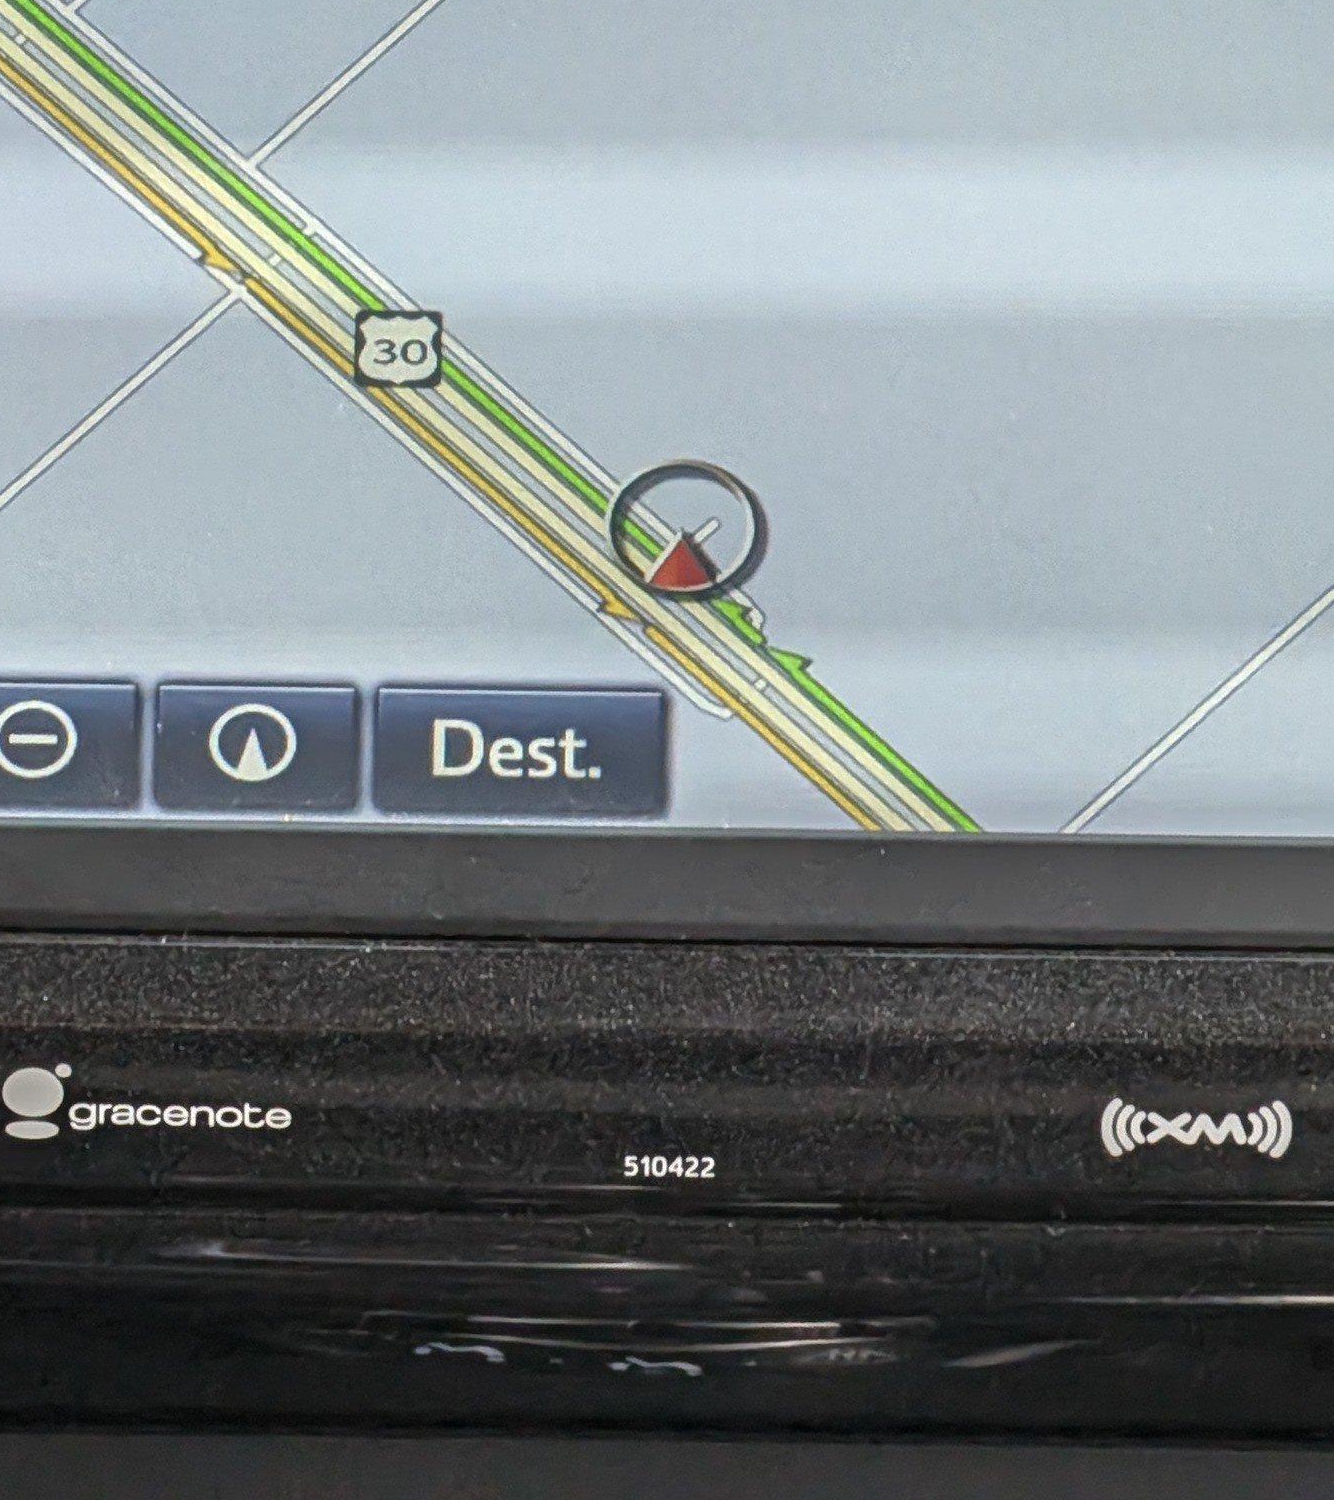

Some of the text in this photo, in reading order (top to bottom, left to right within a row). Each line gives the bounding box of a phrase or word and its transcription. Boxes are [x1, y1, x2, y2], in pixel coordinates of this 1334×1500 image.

[373, 338, 428, 365] 30
[430, 718, 602, 781] Dest.
[67, 1100, 292, 1132] gracenote
[622, 1155, 717, 1180] 510422
